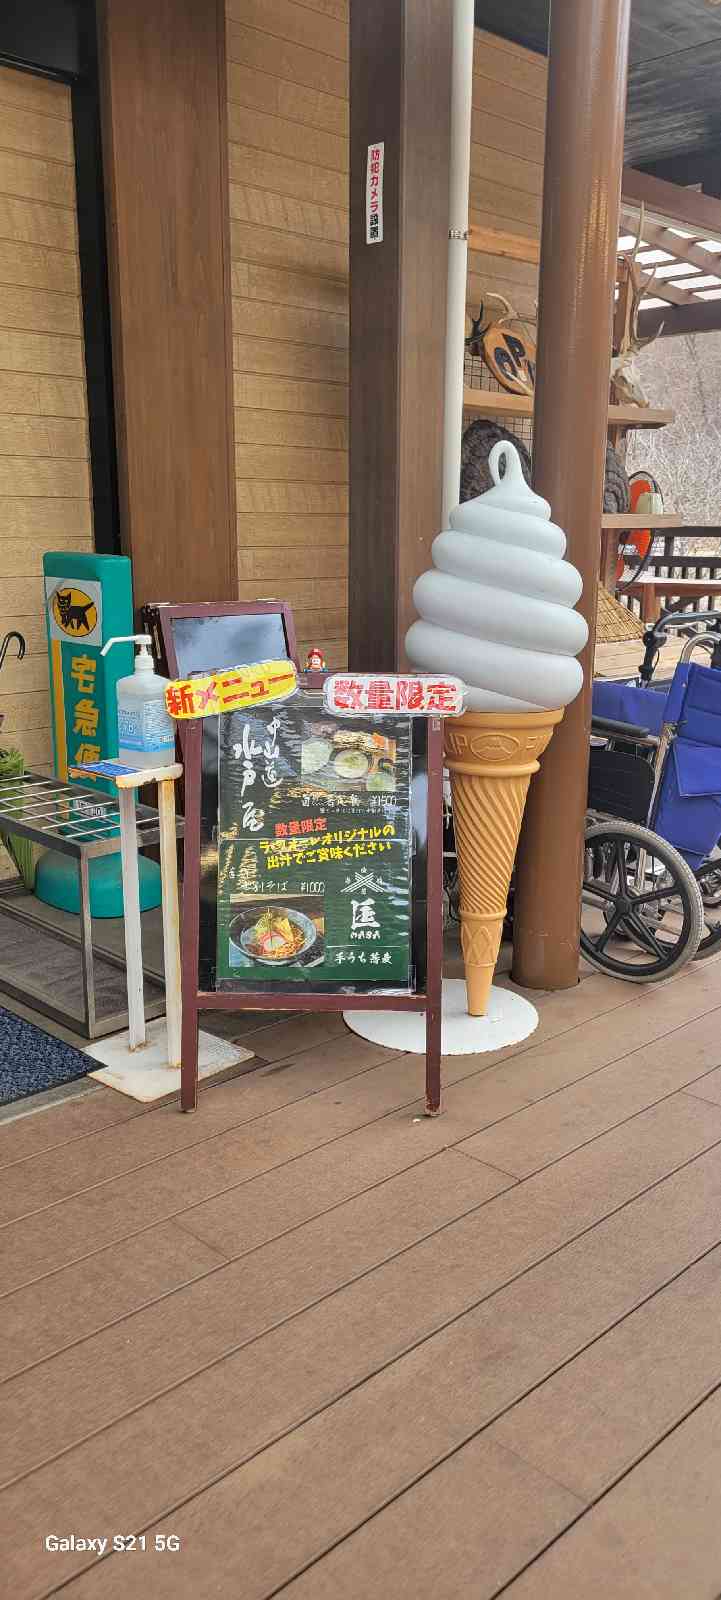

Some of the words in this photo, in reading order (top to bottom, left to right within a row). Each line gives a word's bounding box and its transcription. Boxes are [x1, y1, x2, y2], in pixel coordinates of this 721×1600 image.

[370, 149, 381, 240] 防犯カメラ設置
[166, 672, 295, 715] 新メニュー
[334, 680, 457, 712] 数量限定
[71, 654, 102, 781] 宅急便
[275, 815, 328, 837] 数量限定
[335, 951, 393, 965] 手うち蕎麦
